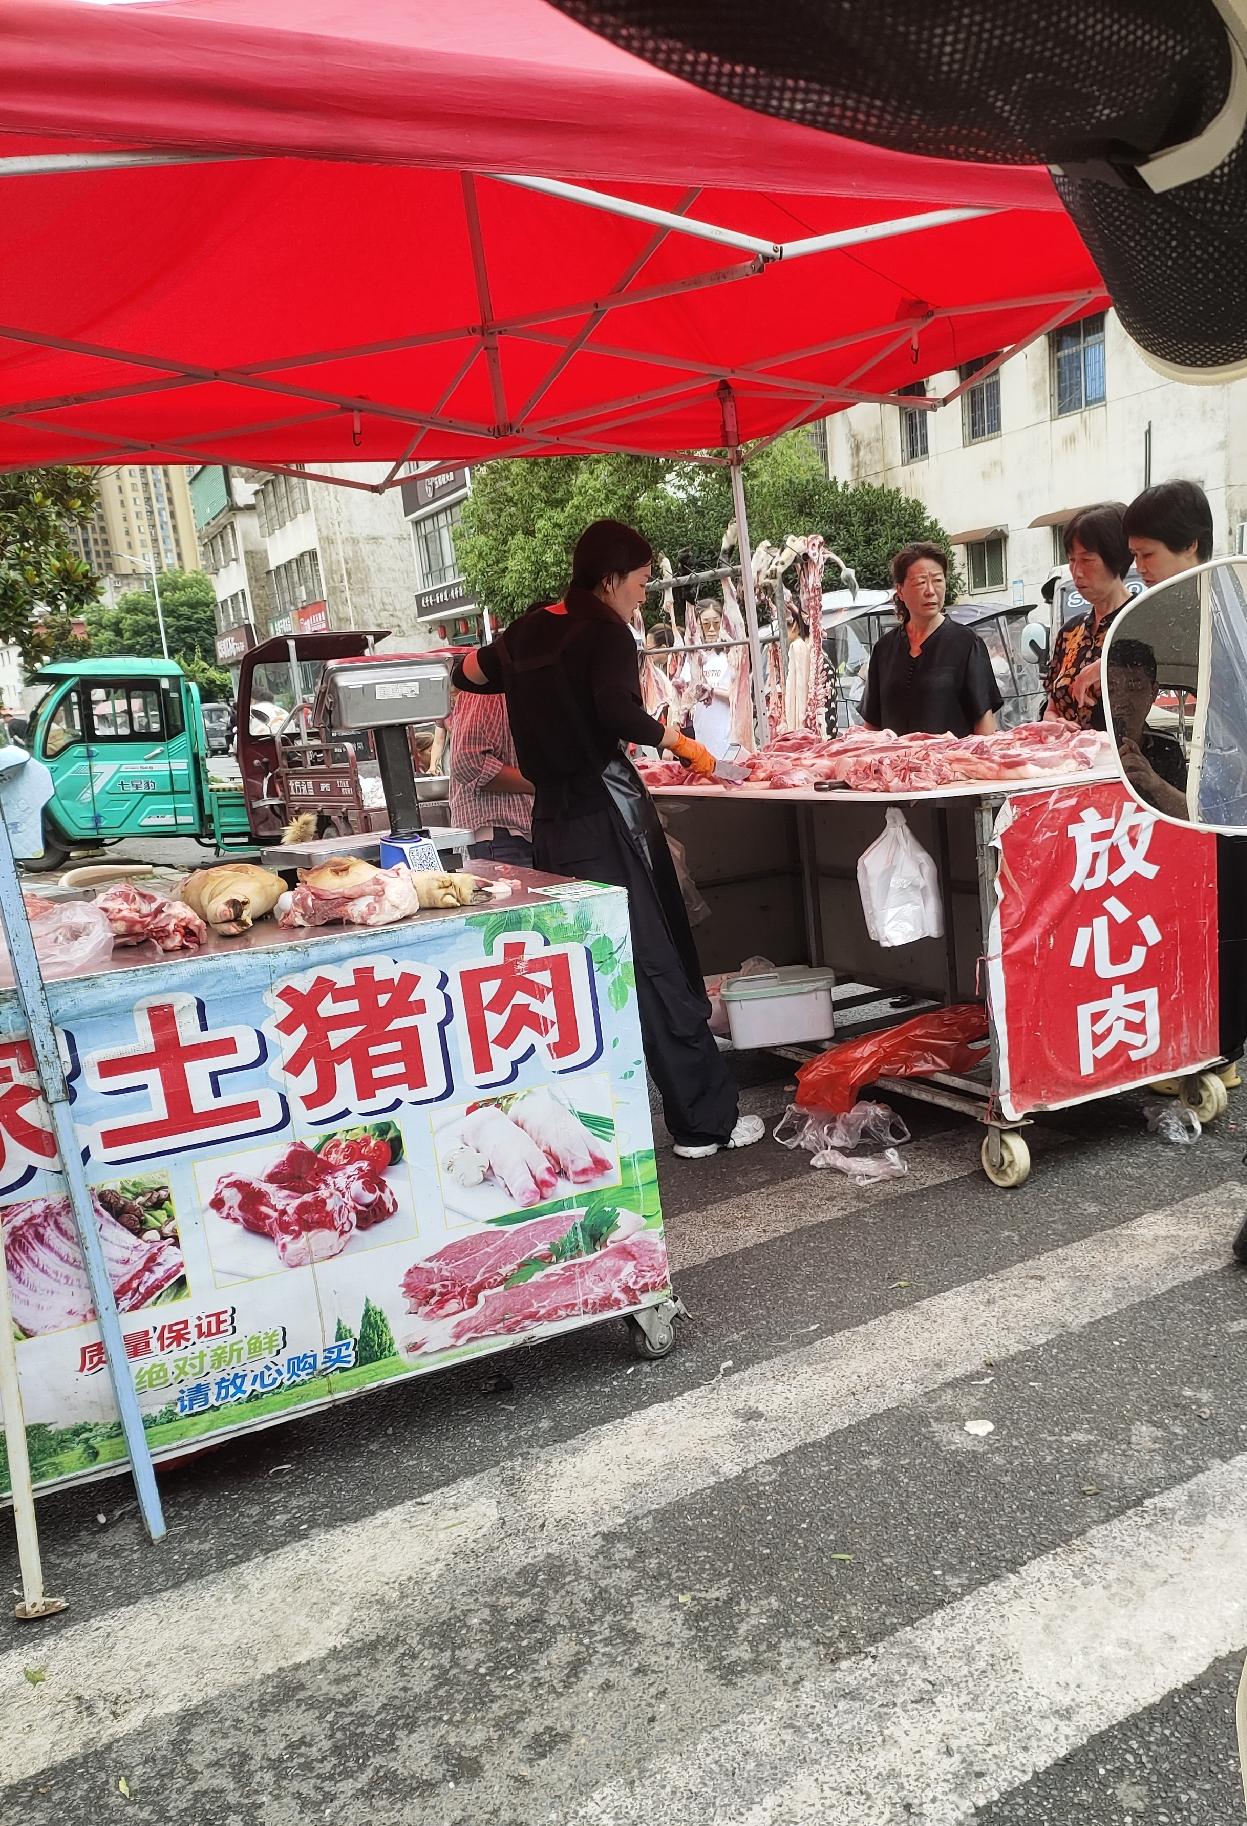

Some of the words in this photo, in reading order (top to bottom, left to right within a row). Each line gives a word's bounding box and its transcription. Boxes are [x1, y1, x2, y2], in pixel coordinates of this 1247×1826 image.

[118, 780, 156, 791] 七星豹
[1067, 801, 1162, 1076] 放心肉
[79, 1308, 232, 1373] 质量保证
[134, 1329, 282, 1392] 绝对新鲜
[176, 1338, 355, 1414] 请放心购买
